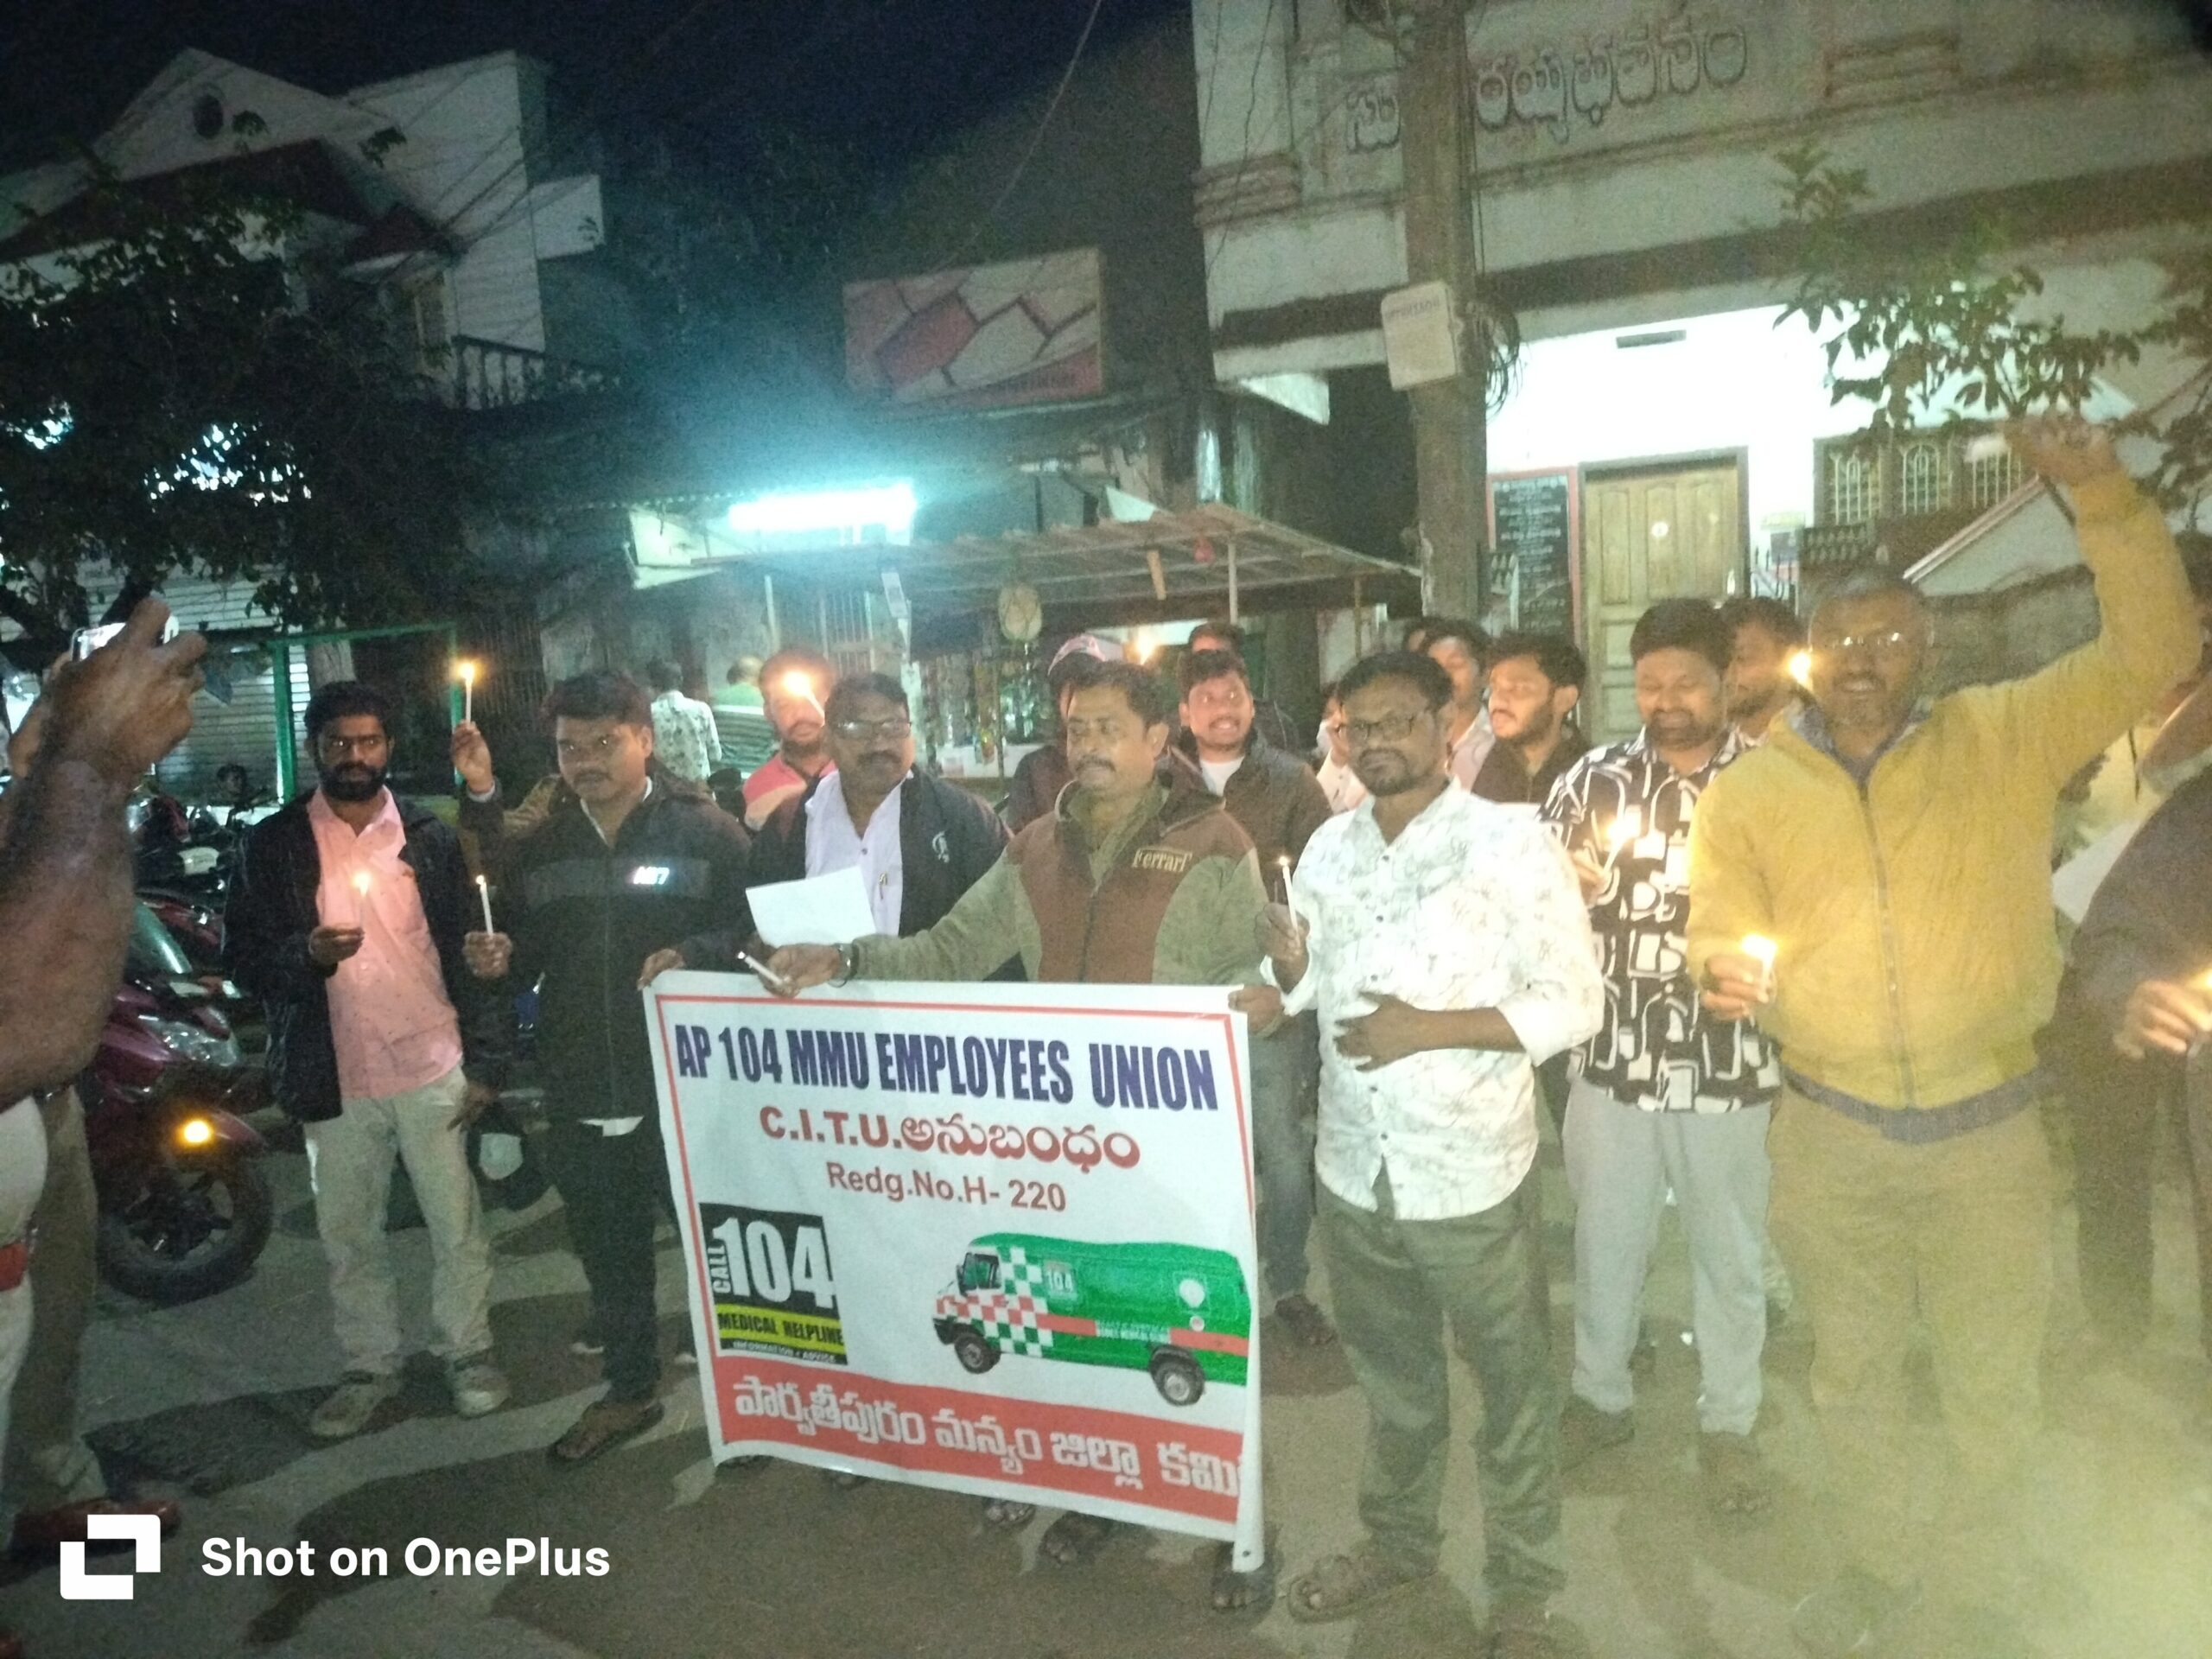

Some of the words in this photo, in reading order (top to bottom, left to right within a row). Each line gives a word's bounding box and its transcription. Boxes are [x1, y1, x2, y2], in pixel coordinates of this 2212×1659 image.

[675, 1025, 711, 1078] AP
[718, 1027, 782, 1084] 104
[786, 1029, 870, 1090] MMU
[874, 1033, 1073, 1104] EMPLOYEES
[1089, 1042, 1218, 1111] UNION
[1007, 1179, 1066, 1212] 220
[707, 1245, 732, 1294] CALL
[712, 1217, 837, 1309] 104
[717, 1312, 778, 1335] MEDICAL
[782, 1319, 844, 1346] HELPLINE
[734, 1375, 926, 1445] పార్వతీపురం
[931, 1408, 1043, 1475] మన్యం
[1050, 1431, 1145, 1491] జిల్లా
